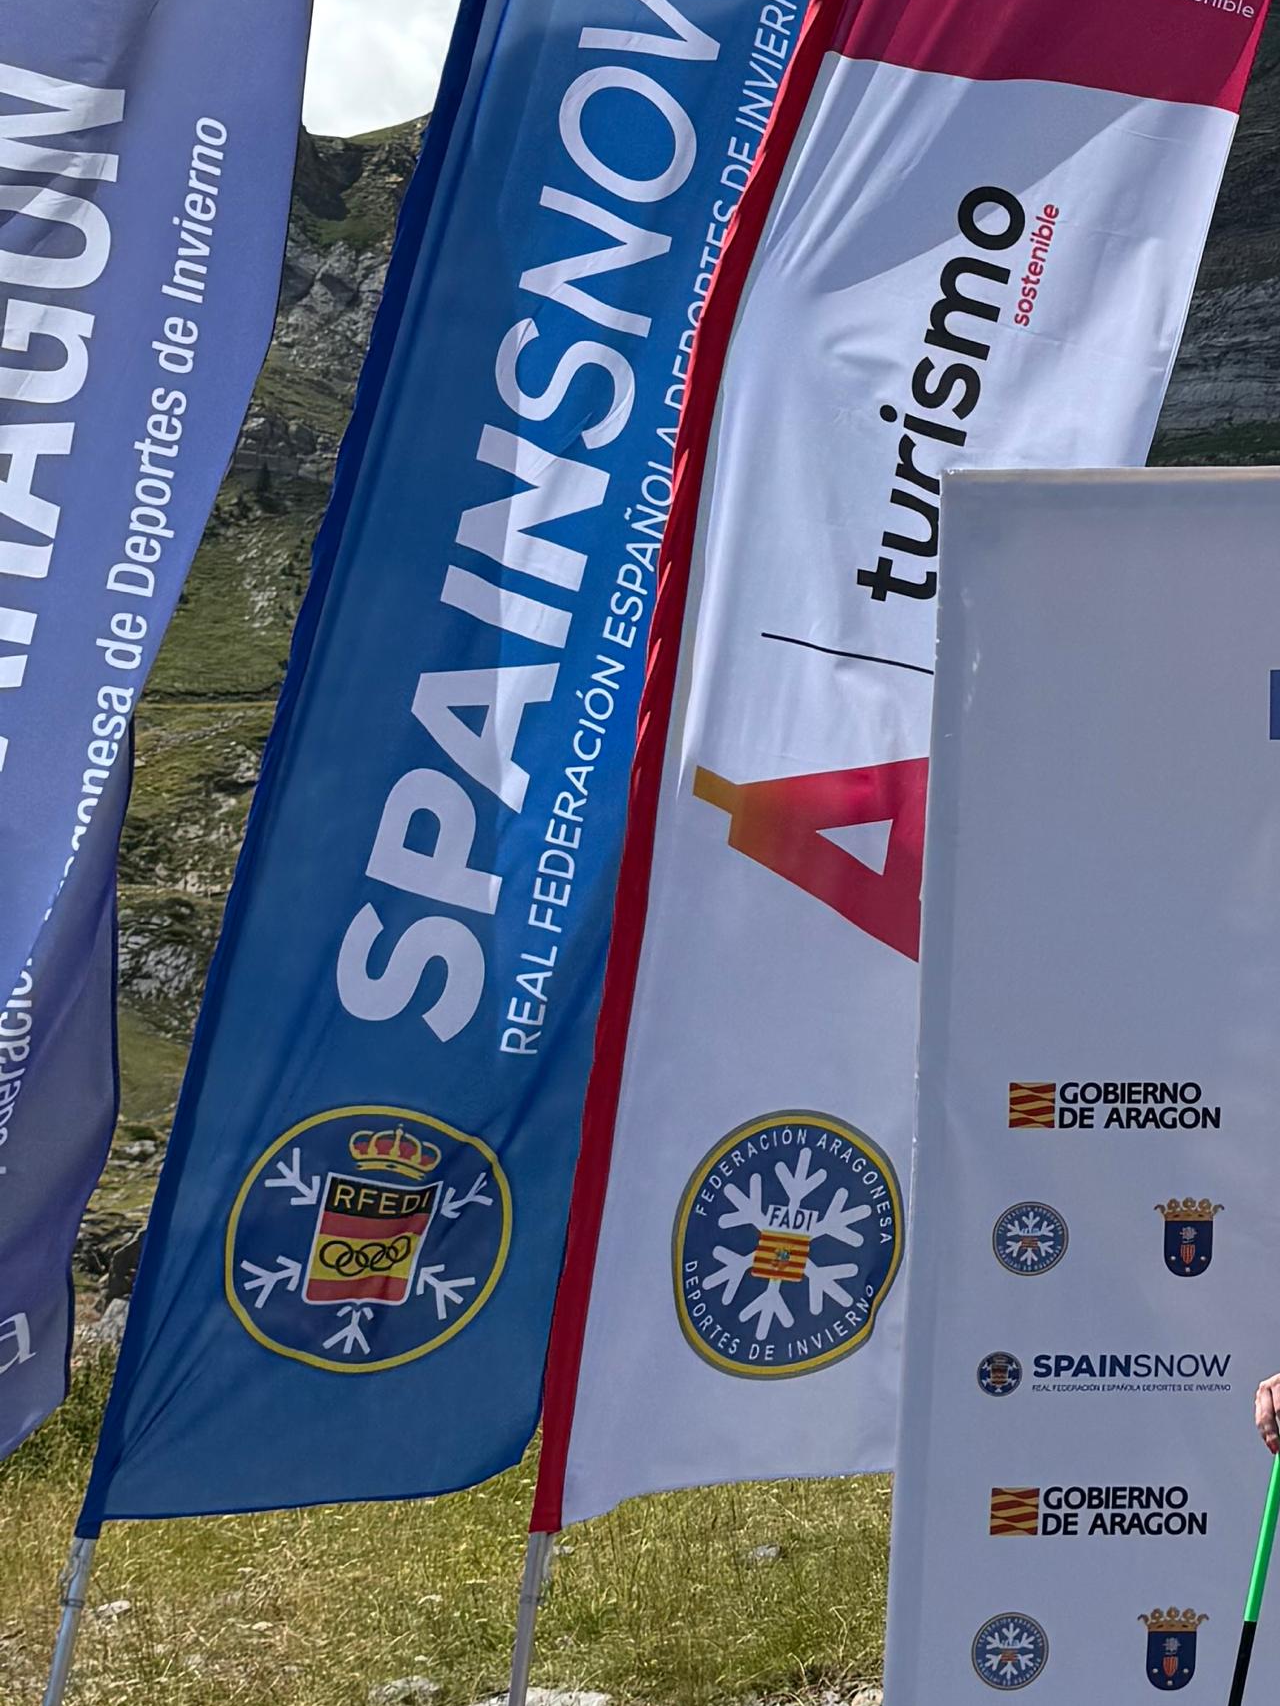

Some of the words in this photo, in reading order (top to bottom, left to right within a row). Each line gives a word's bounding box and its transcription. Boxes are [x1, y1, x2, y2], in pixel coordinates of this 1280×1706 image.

[172, 116, 228, 305] Invierno
[1014, 202, 1060, 328] sostenible
[151, 313, 198, 375] de
[856, 186, 1025, 603] turismo
[107, 385, 188, 599] Deportes
[96, 610, 148, 671] de
[500, 945, 556, 1057] REAL
[528, 655, 626, 934] FEDERACIÓN
[1058, 1107, 1094, 1129] DE
[1103, 1106, 1221, 1129] ARAGON
[1059, 1082, 1202, 1104] GOBIERNO
[333, 1184, 430, 1215] RFEDI
[696, 1126, 807, 1217] FEDERACIÓN
[816, 1133, 893, 1245] ARAGONESA
[768, 1206, 813, 1232] FADI
[685, 1260, 741, 1355] DEPORTES
[749, 1343, 774, 1361] DE
[787, 1284, 874, 1358] INVIERNO
[1033, 1354, 1231, 1378] SPAINSNOW
[1042, 1513, 1078, 1536] DE
[1089, 1512, 1207, 1536] ARAGON
[1044, 1486, 1188, 1510] GOBIERNO
